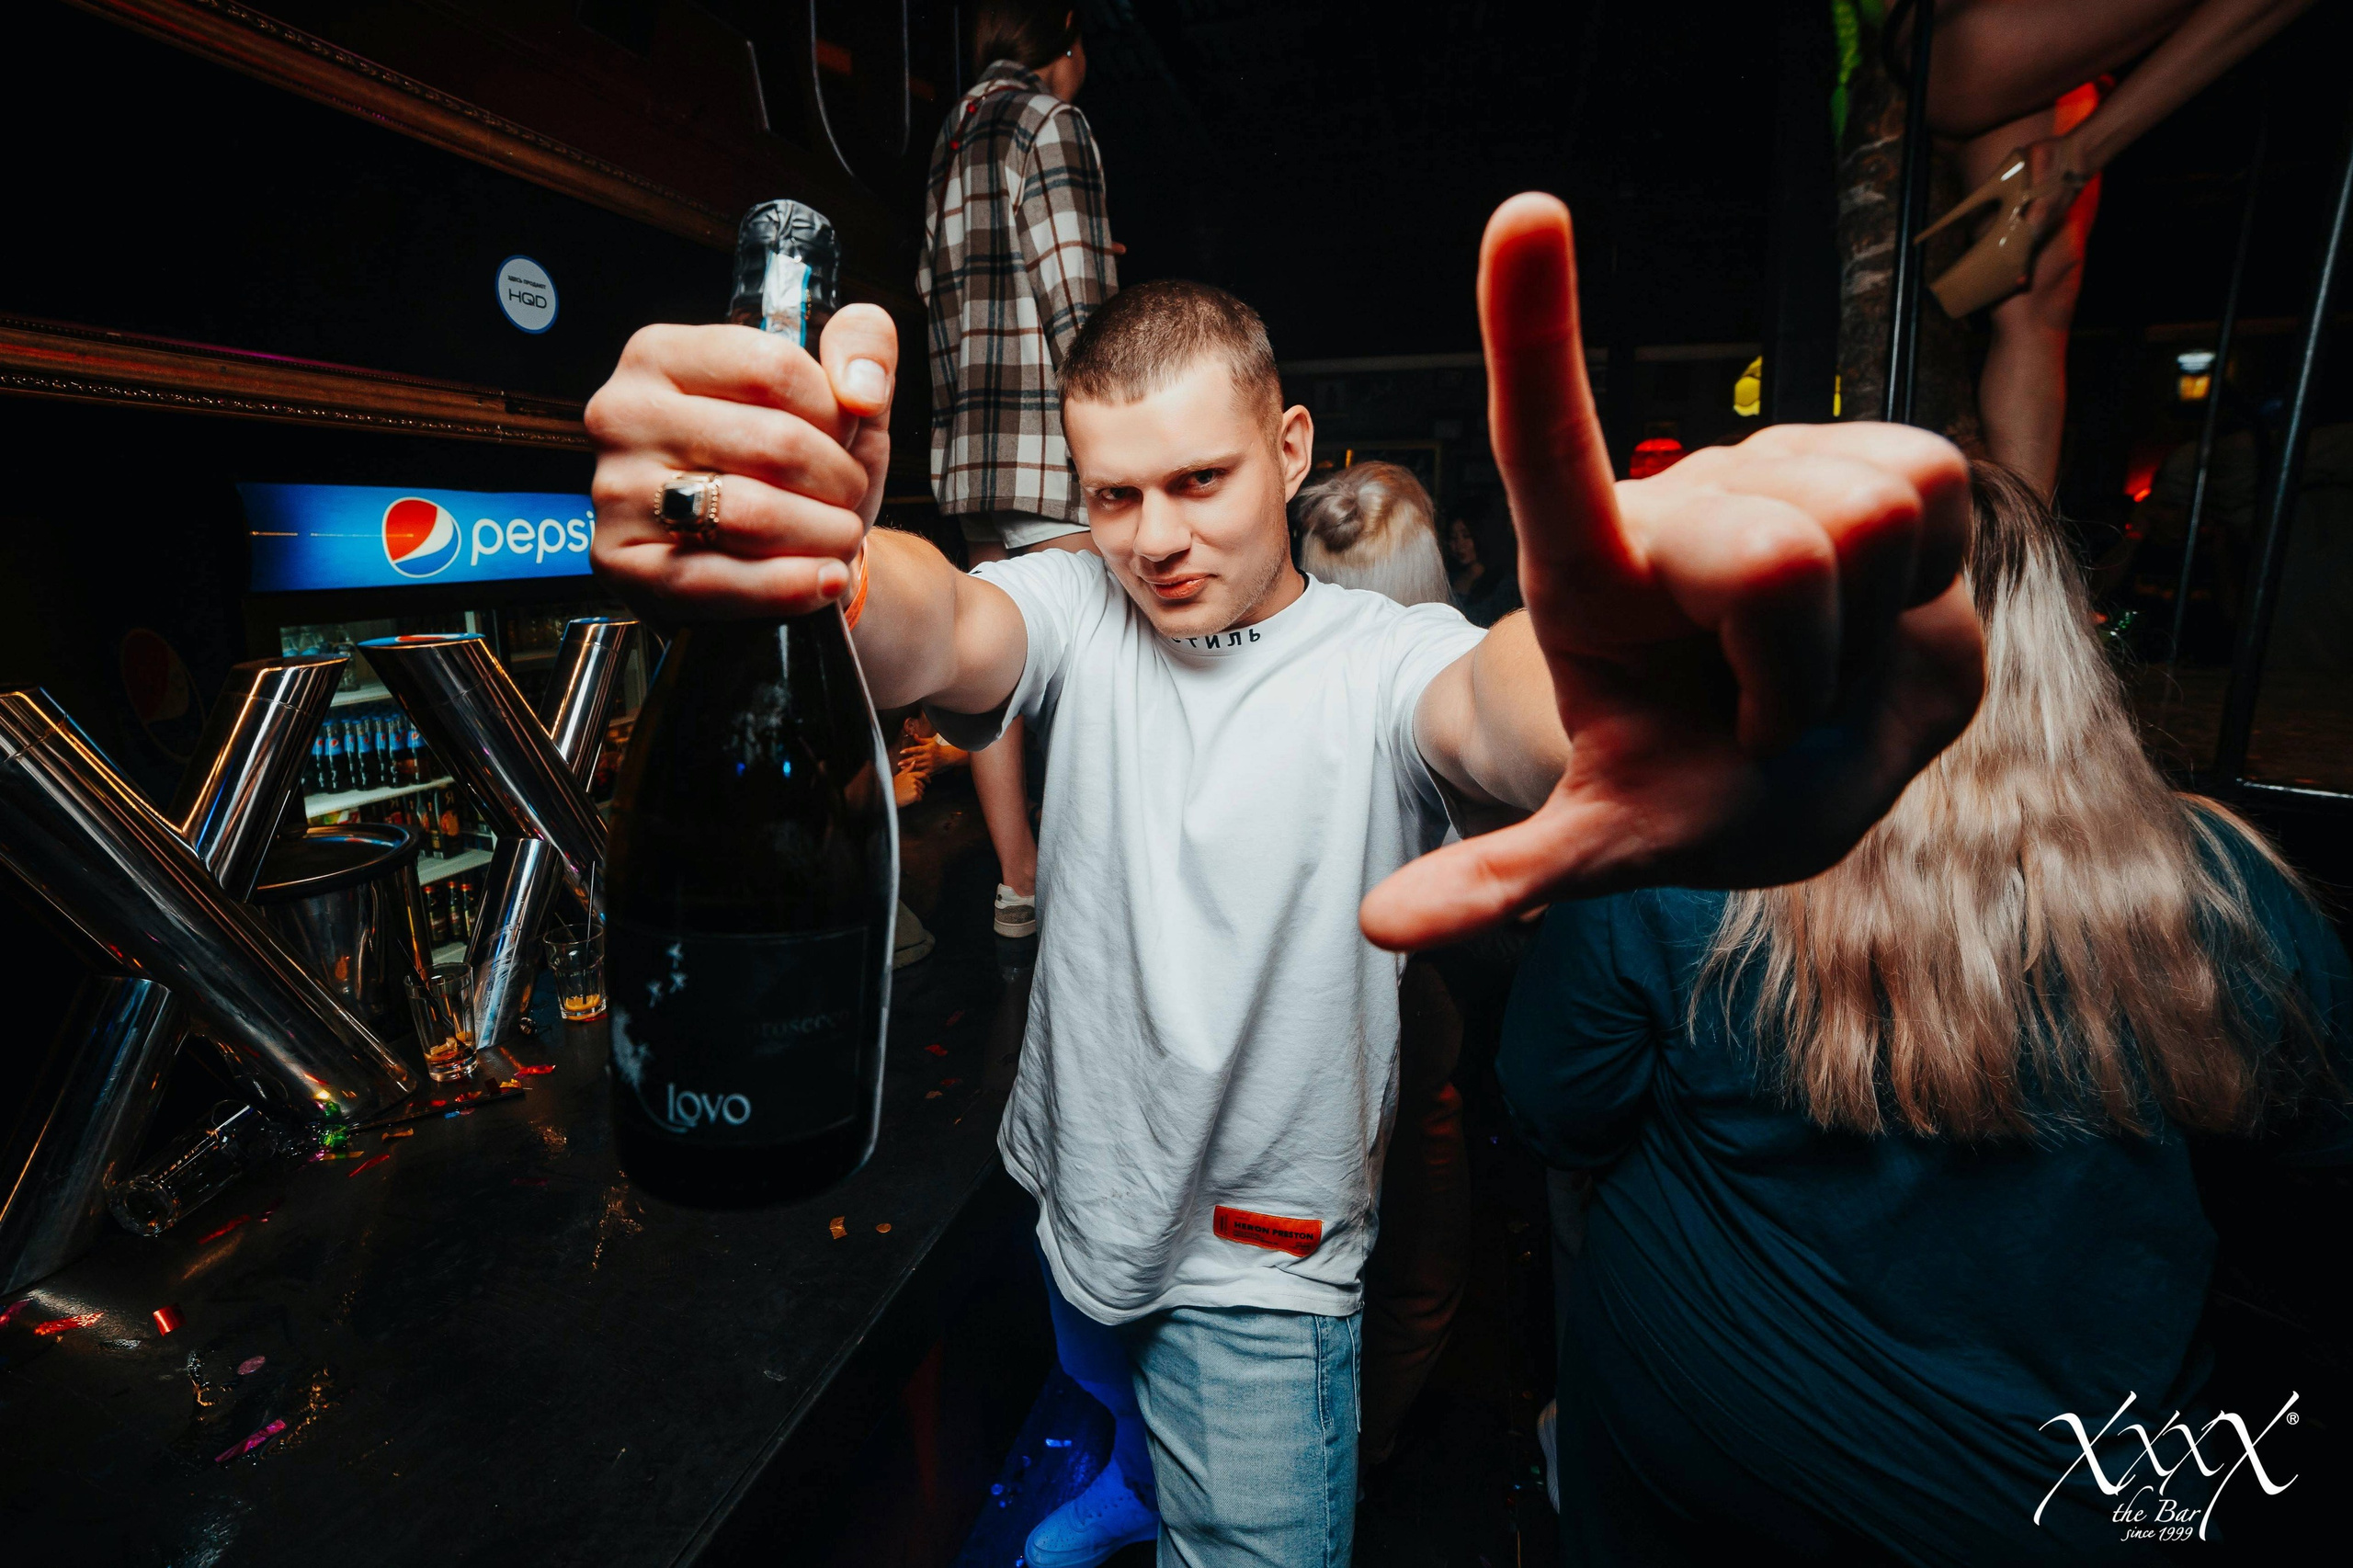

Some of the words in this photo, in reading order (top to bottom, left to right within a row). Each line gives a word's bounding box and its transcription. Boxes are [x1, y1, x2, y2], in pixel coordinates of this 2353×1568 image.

[508, 289, 548, 309] HQD
[470, 510, 596, 566] pepsi
[1170, 629, 1261, 649] ТИЛЬ
[1234, 1221, 1269, 1234] HERON
[1272, 1229, 1314, 1241] PRESTON
